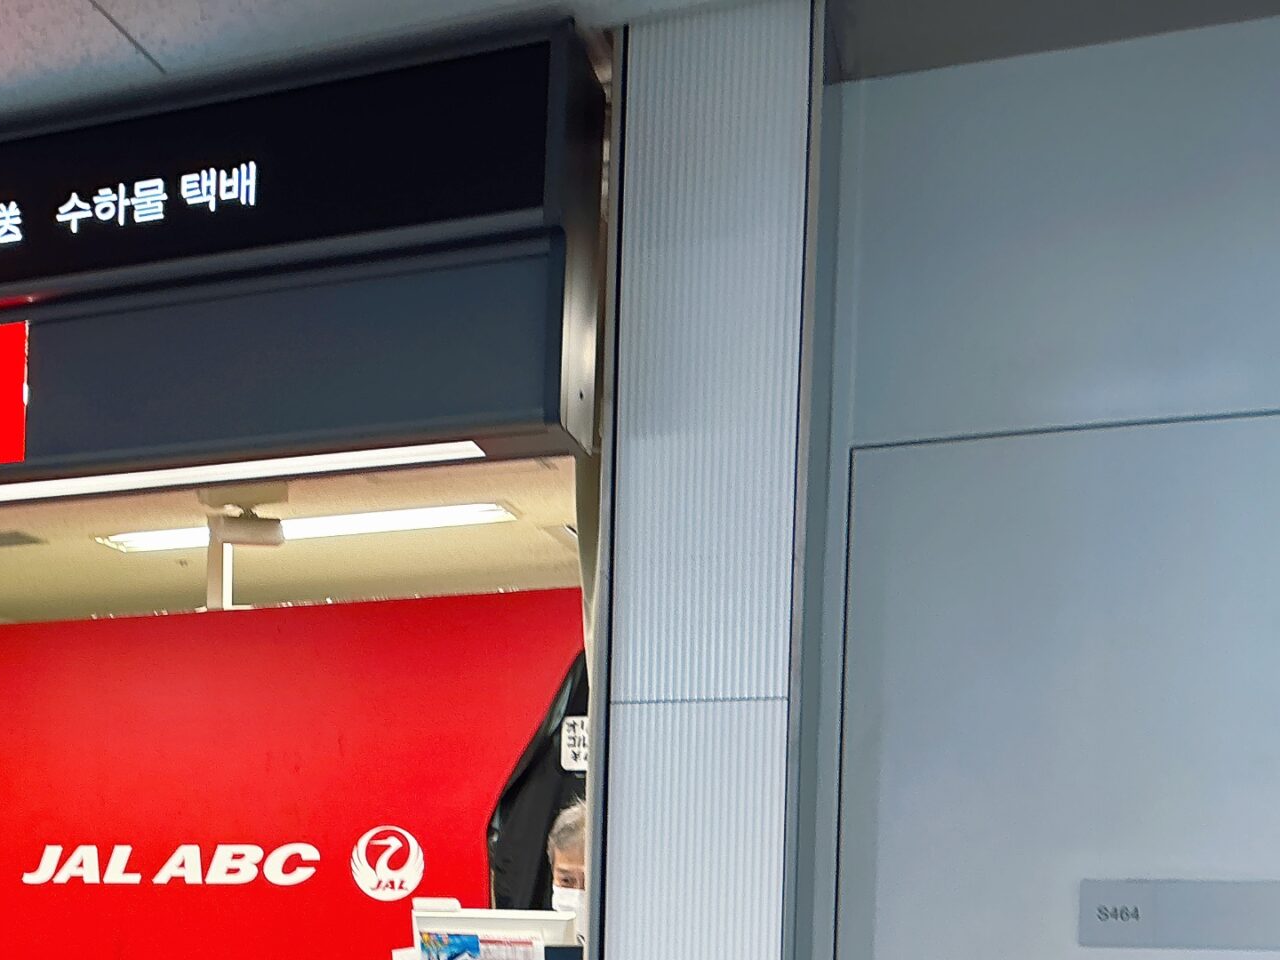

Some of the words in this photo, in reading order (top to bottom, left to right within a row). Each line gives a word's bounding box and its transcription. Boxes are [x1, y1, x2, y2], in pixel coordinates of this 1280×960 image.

[56, 178, 168, 234] 수하물
[180, 160, 257, 212] 택배
[22, 844, 142, 885] JAL
[152, 842, 321, 886] ABC
[370, 878, 408, 892] JAL
[1096, 905, 1140, 922] S464
